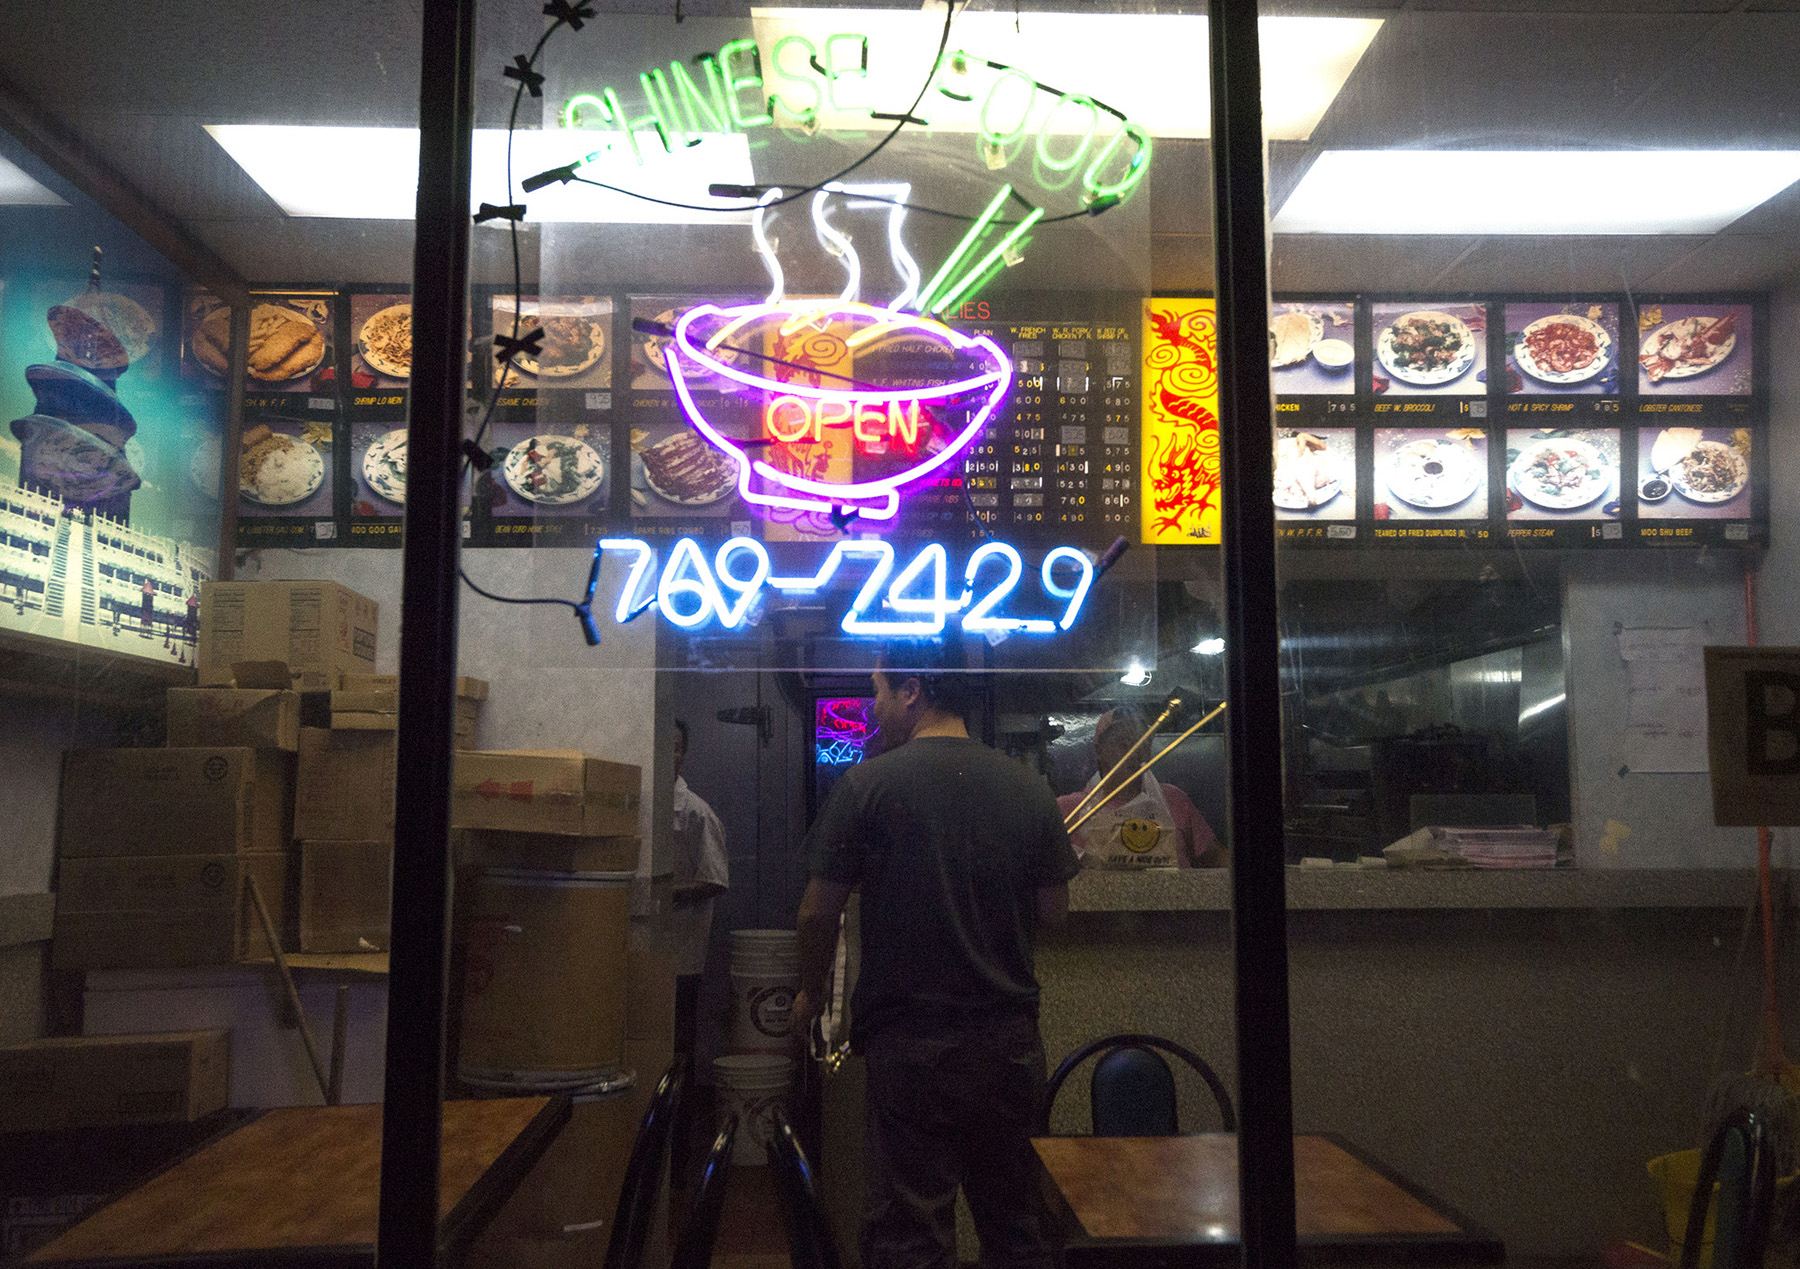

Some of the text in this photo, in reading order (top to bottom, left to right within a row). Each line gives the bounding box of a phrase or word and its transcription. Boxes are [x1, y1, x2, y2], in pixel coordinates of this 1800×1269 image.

[562, 34, 1152, 196] CHINESE FOOD
[902, 345, 920, 353] HALF
[377, 397, 387, 405] LO
[1374, 404, 1392, 412] BEEF
[1403, 404, 1436, 412] BROCCOLI
[1508, 404, 1522, 412] HOT
[1531, 404, 1549, 412] SPICY
[1551, 404, 1574, 412] SHRIMP
[1639, 404, 1703, 412] LOBSTER CANTONESE
[767, 396, 920, 444] OPEN
[1398, 529, 1407, 537] OR
[1408, 529, 1424, 537] FRIED
[1425, 529, 1457, 537] DUMPLINGS
[1507, 529, 1555, 537] PEPPER STEAK
[1641, 529, 1693, 537] MOO SHU BEEF
[597, 537, 1098, 633] 769-7429
